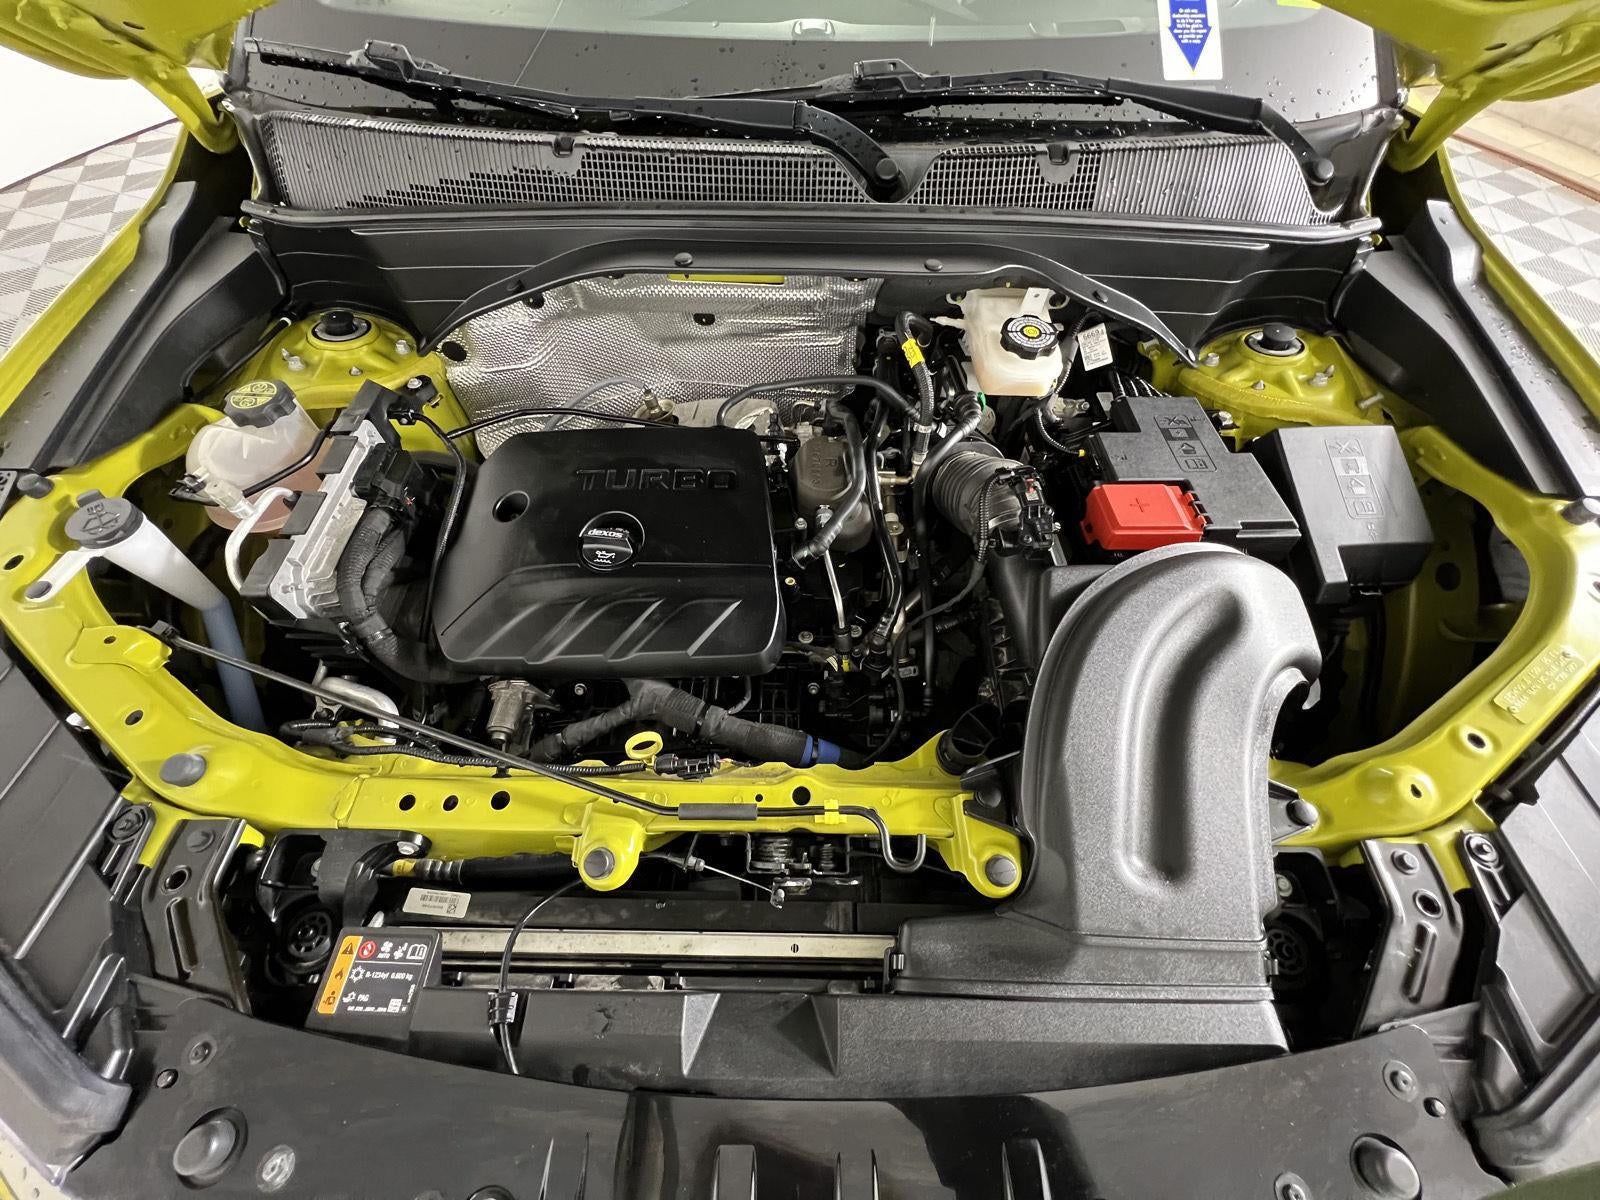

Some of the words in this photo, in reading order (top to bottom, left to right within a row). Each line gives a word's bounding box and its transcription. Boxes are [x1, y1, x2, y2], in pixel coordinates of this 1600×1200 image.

[576, 468, 737, 491] TURBO
[587, 528, 623, 539] dexos
[357, 994, 370, 1002] PAG
